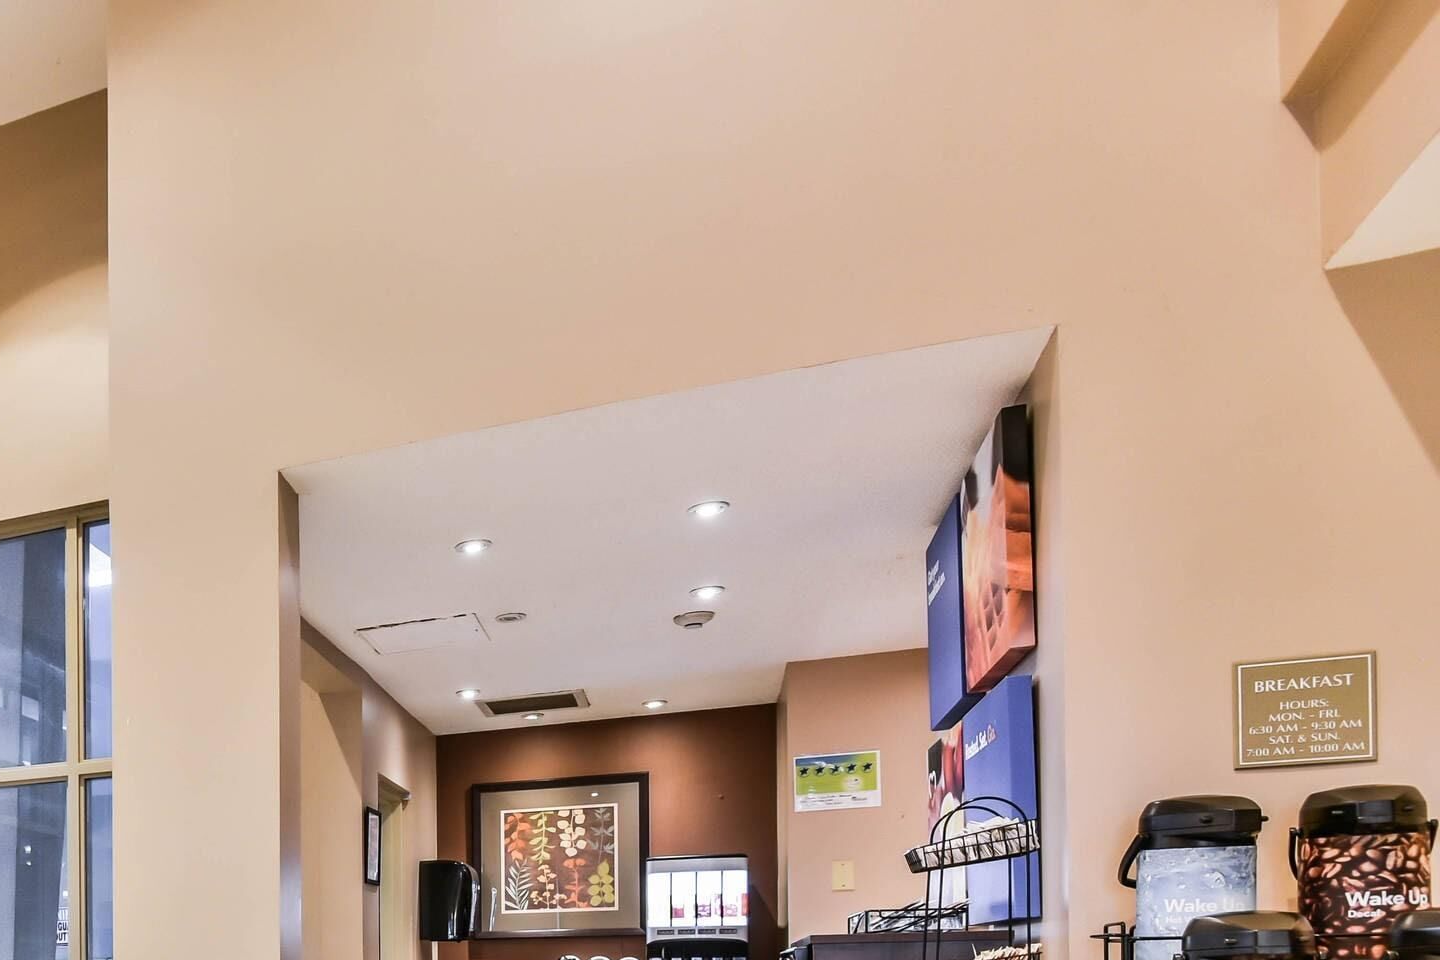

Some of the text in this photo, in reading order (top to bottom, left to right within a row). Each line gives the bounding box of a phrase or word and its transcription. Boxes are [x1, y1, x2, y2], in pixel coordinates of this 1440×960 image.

[1254, 673, 1355, 693] BREAKFAST
[1279, 698, 1329, 710] HOURS:
[1268, 712, 1305, 722] MON.
[1248, 726, 1273, 735] 6:30
[1276, 723, 1298, 733] AM
[1311, 721, 1336, 730] 9:30
[1339, 719, 1363, 729] AM
[1269, 735, 1294, 745] SAT.
[1297, 734, 1307, 743] &
[1246, 748, 1270, 757] 7:00
[1272, 746, 1296, 755] AM
[1309, 743, 1339, 753] 10:00
[1342, 742, 1365, 751] AM
[1164, 898, 1218, 913] Wake
[1345, 889, 1428, 907] Wake Up
